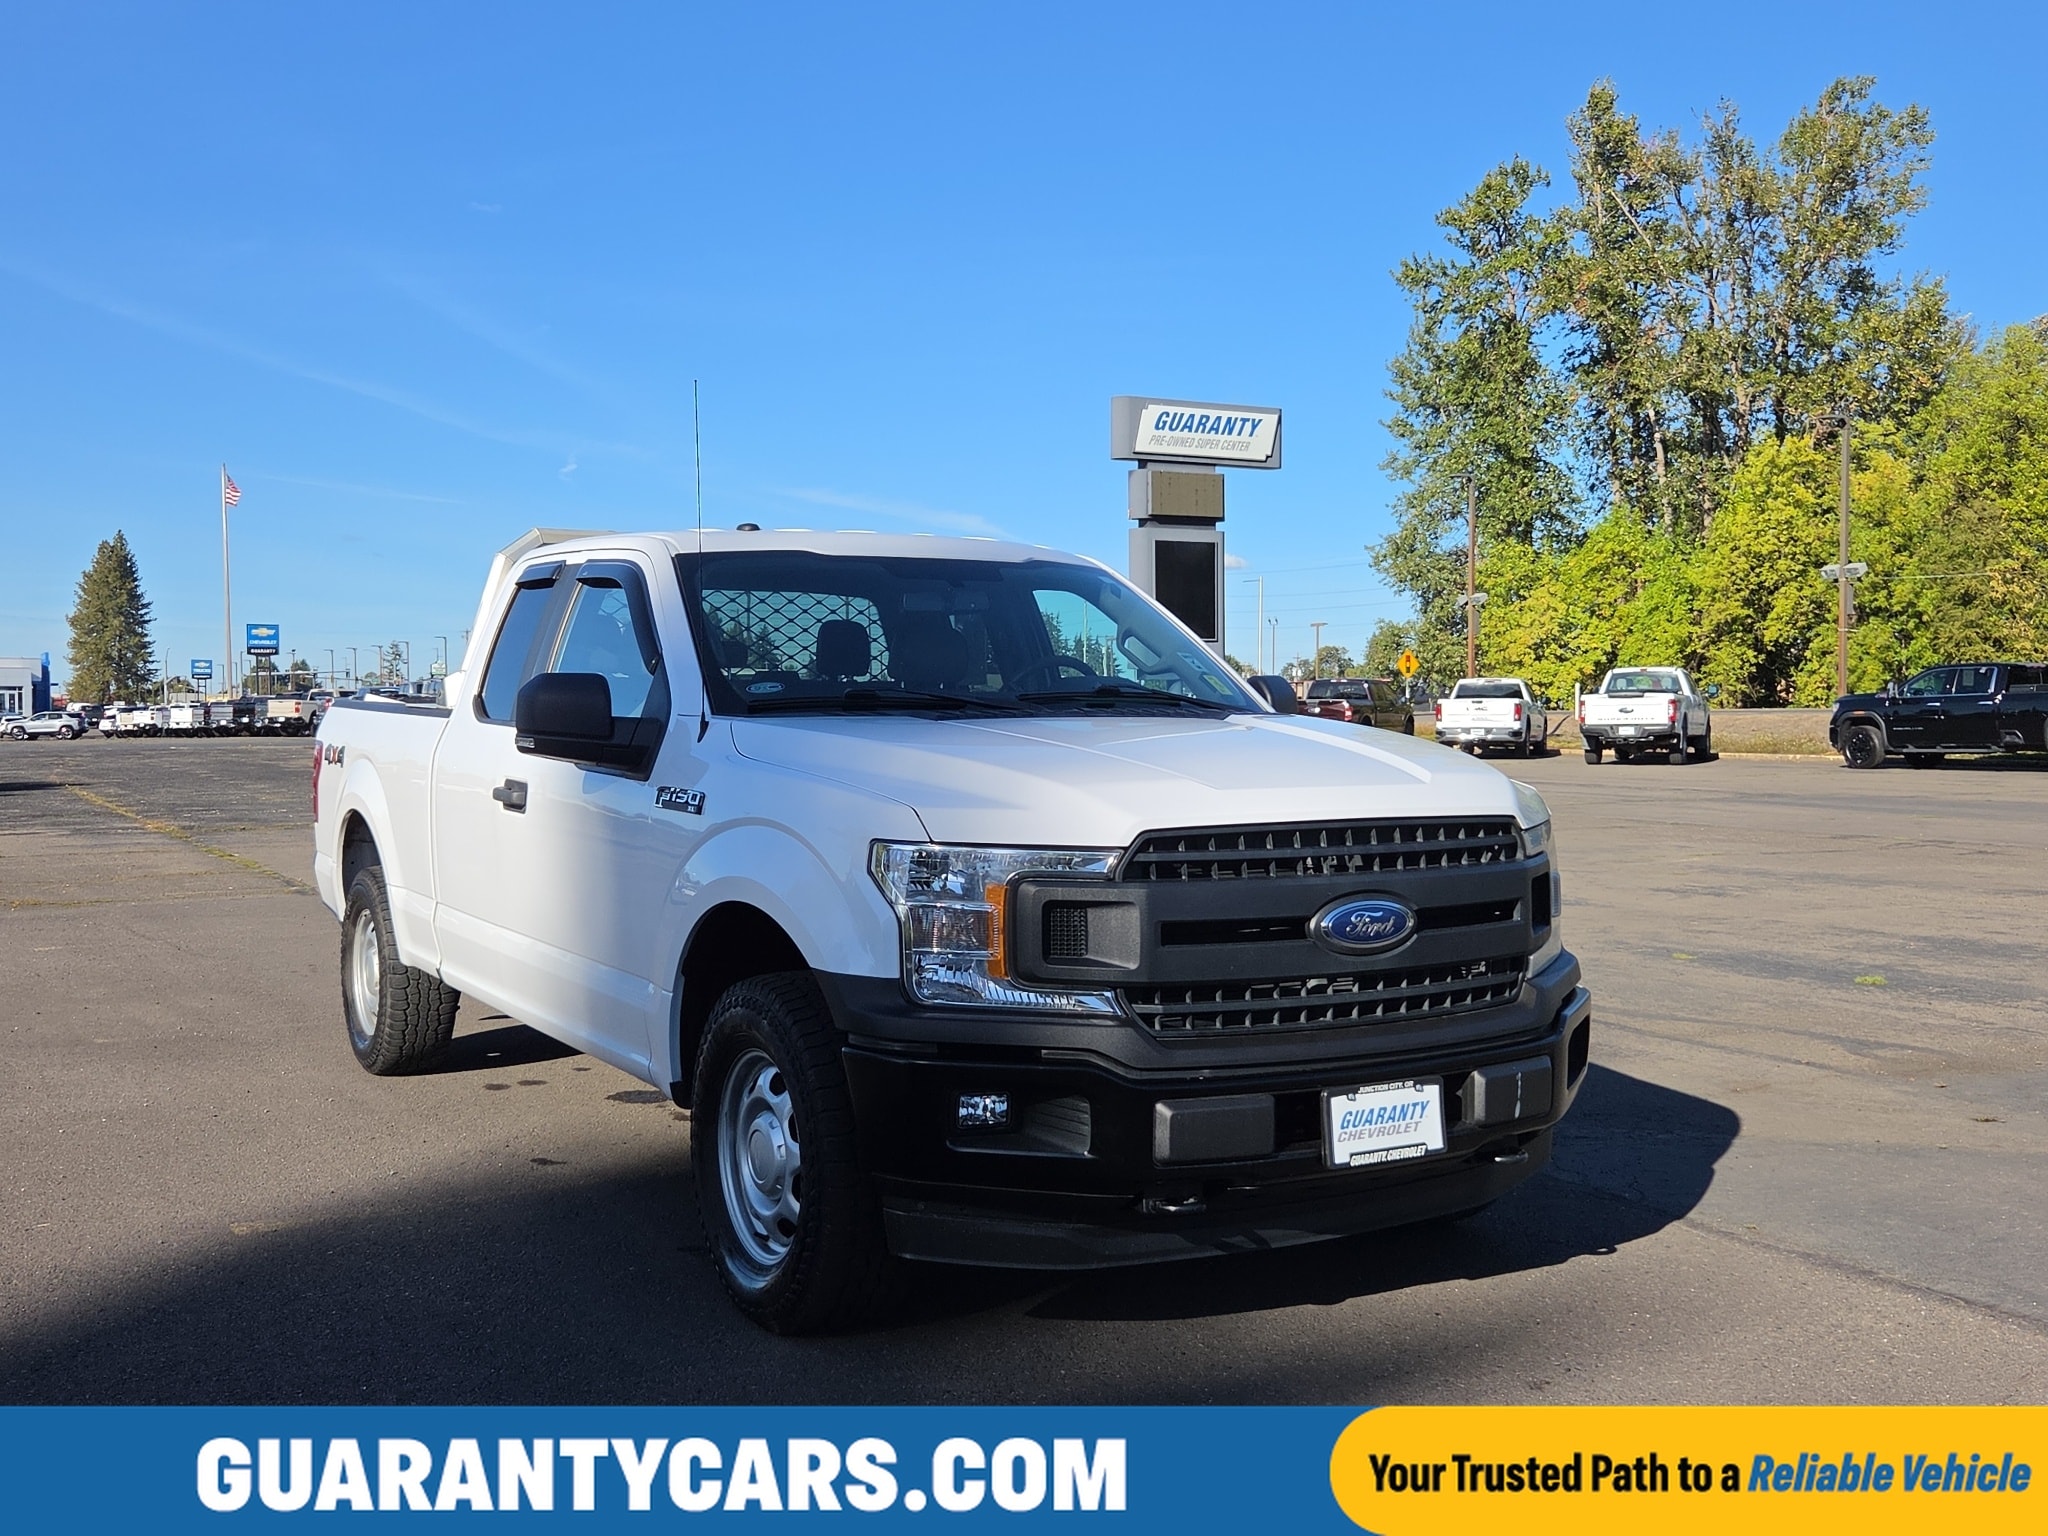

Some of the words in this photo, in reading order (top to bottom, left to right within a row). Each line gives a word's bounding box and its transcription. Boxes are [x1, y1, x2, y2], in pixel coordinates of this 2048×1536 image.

[1154, 411, 1263, 437] GUARANTY
[1149, 434, 1196, 448] PRE-OWNED
[1195, 438, 1221, 451] SUPER
[1220, 440, 1251, 452] CENTER
[1346, 911, 1396, 937] Ford
[1358, 1083, 1389, 1094] JUNCTION
[1404, 1080, 1414, 1088] OR
[1340, 1100, 1430, 1130] GUARANTY
[1337, 1121, 1422, 1142] CHEVROLET
[1387, 1145, 1427, 1161] CHEVROLET
